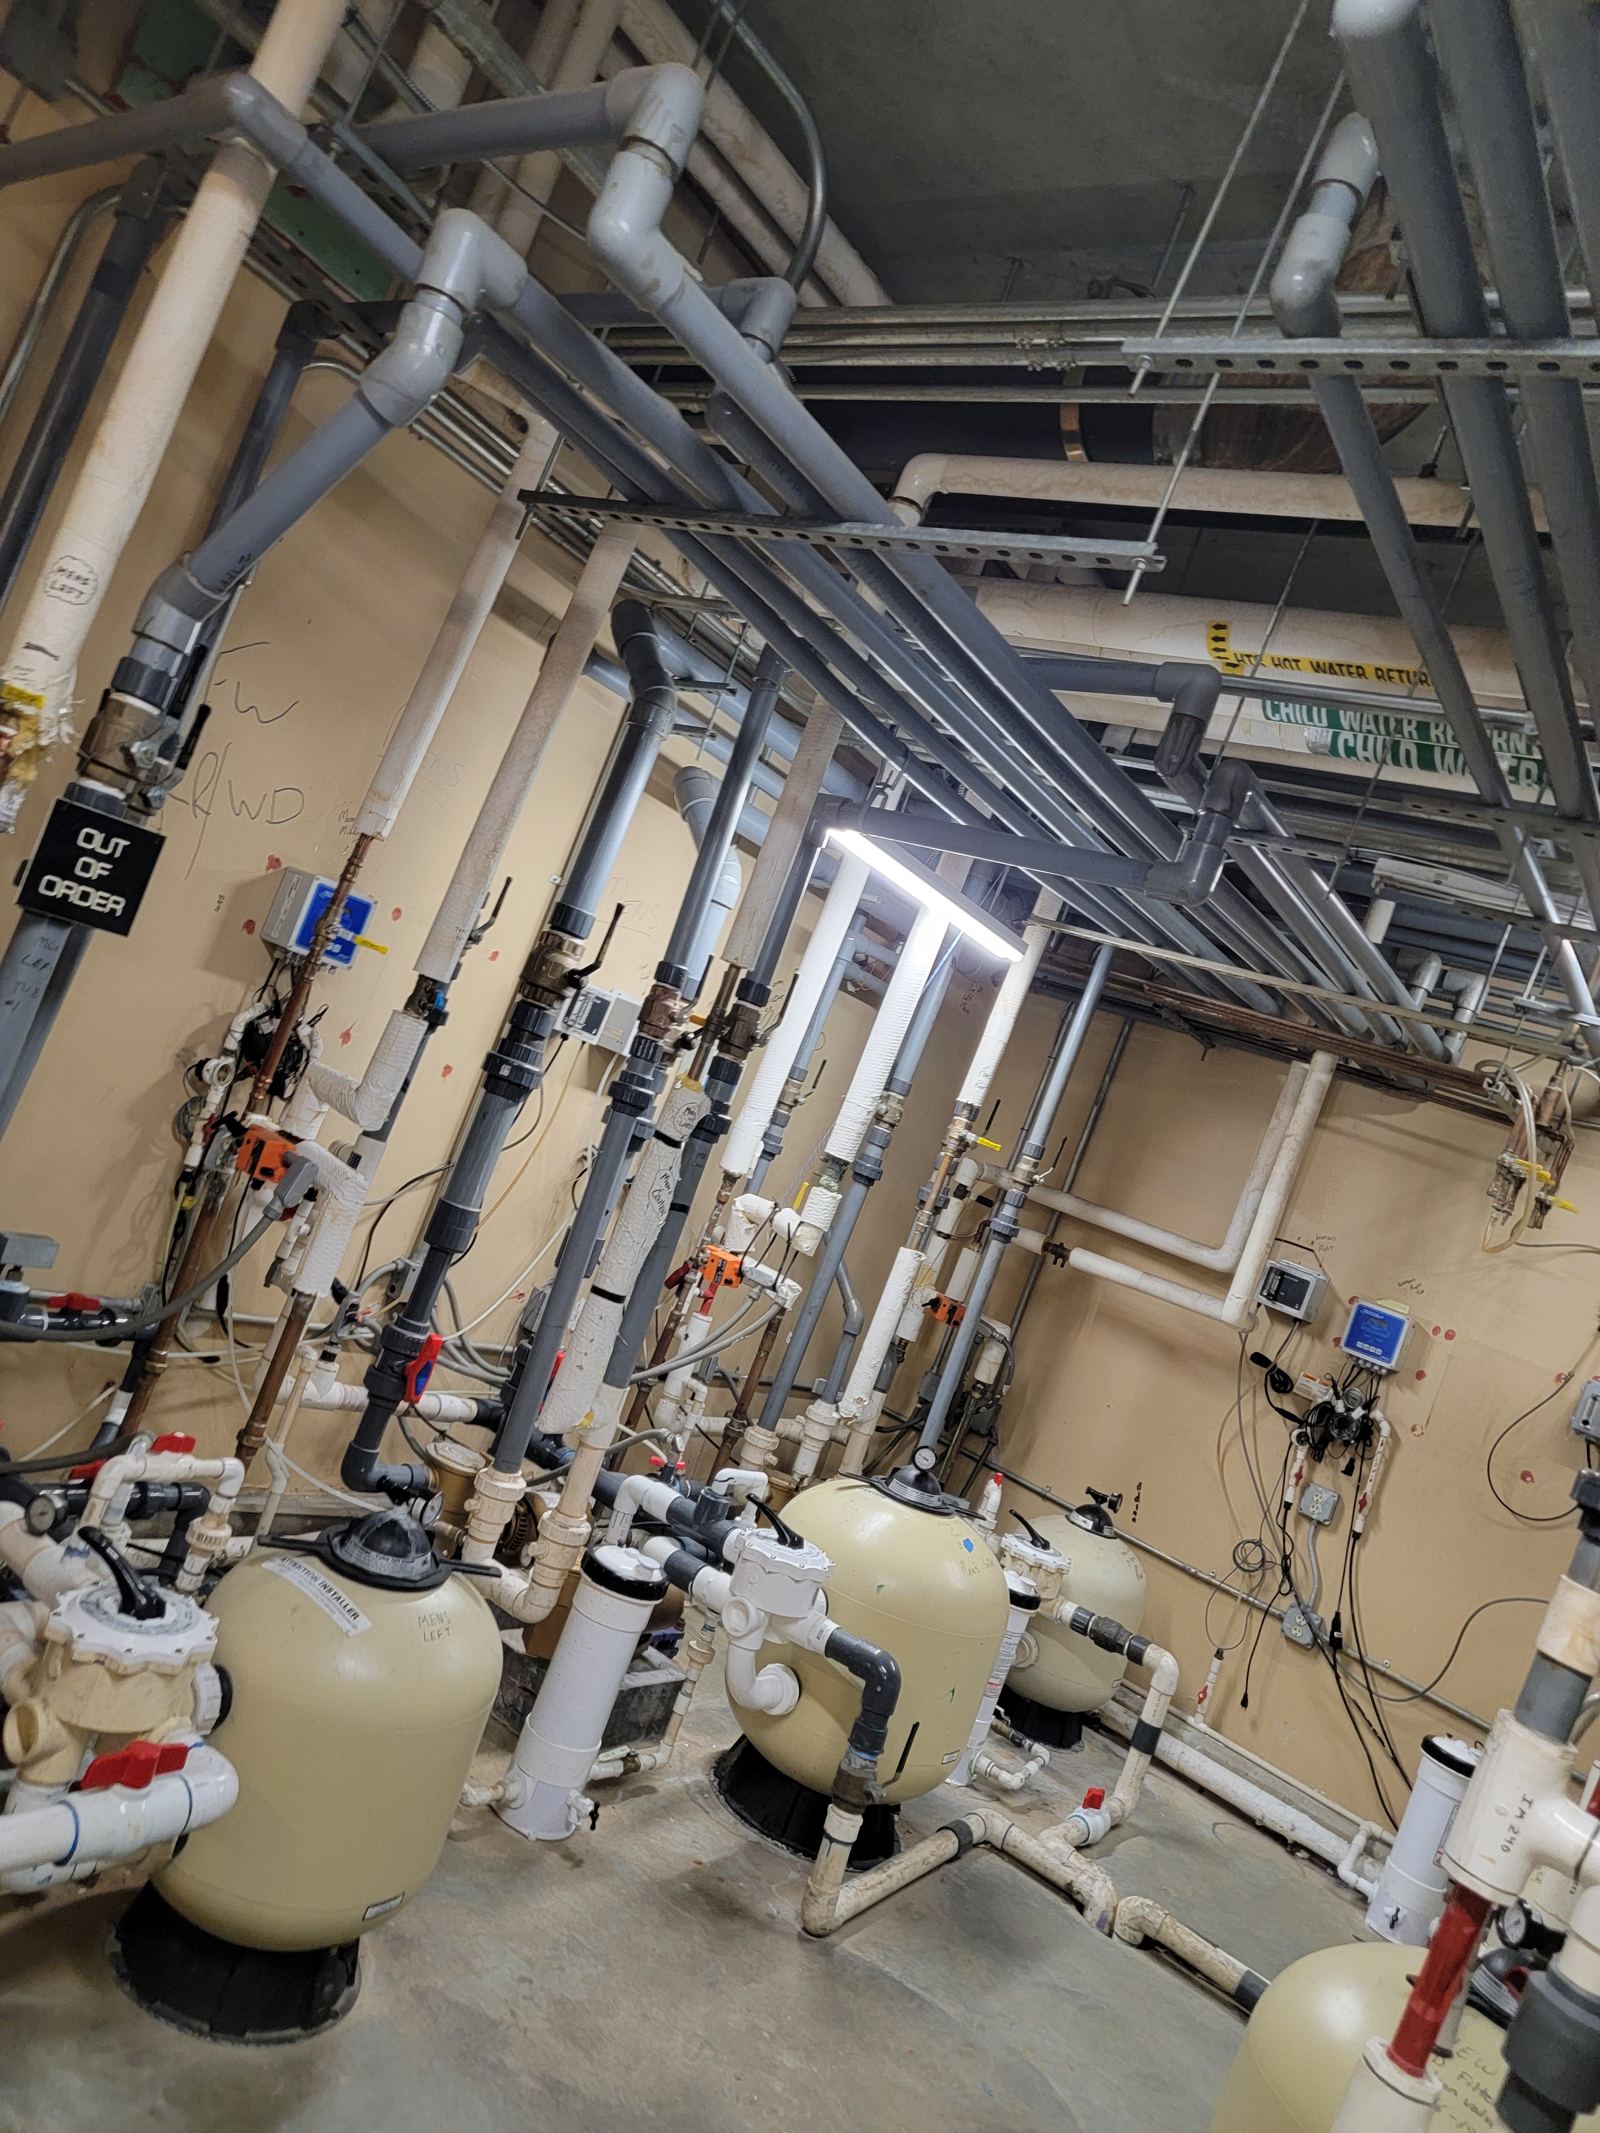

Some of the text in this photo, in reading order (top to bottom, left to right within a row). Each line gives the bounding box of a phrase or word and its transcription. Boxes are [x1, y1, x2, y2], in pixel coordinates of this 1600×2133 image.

[1310, 660, 1369, 680] WATER
[1374, 667, 1432, 688] RETUR
[1339, 709, 1419, 741] WATER
[76, 827, 131, 859] OUT
[74, 856, 114, 880] OF
[38, 874, 127, 917] ORDER
[281, 1555, 321, 1583] ATTENTION
[318, 1580, 360, 1621] INSTALLER
[418, 1610, 452, 1629] MENS
[423, 1627, 452, 1643] LEFT
